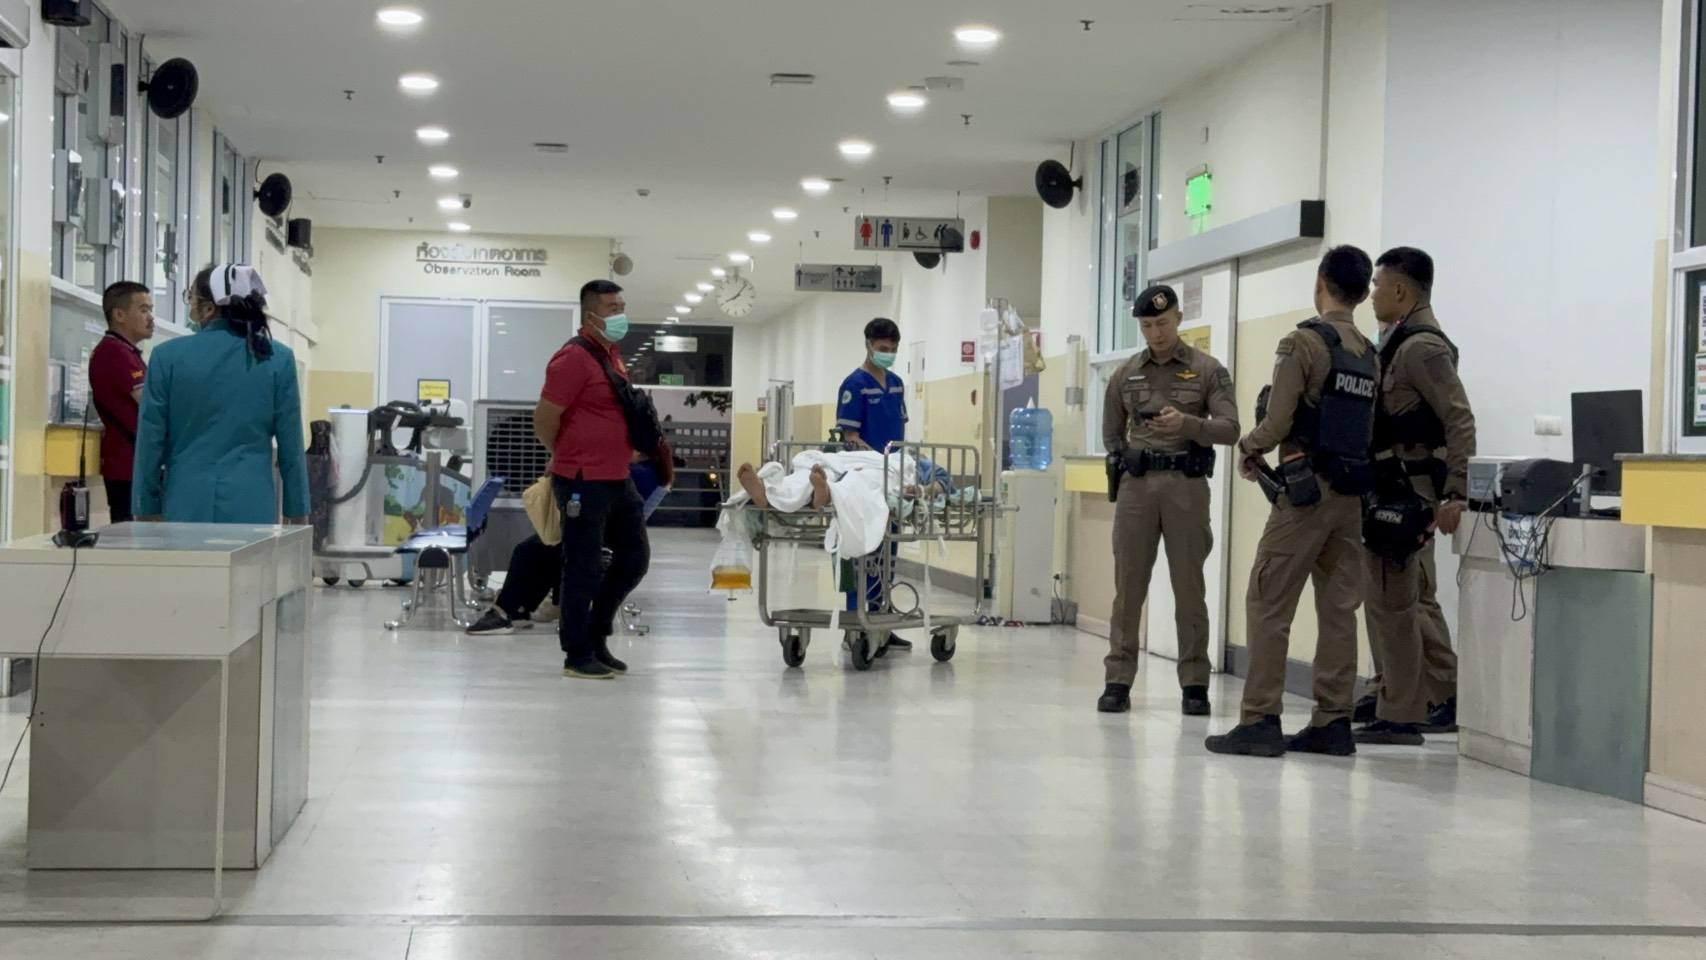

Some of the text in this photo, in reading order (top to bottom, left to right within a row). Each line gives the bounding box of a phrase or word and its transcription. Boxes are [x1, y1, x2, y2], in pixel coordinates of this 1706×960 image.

[416, 241, 546, 261] ห้องเกตอาการ
[424, 263, 541, 277] Observation Room
[1335, 372, 1374, 398] POLICE
